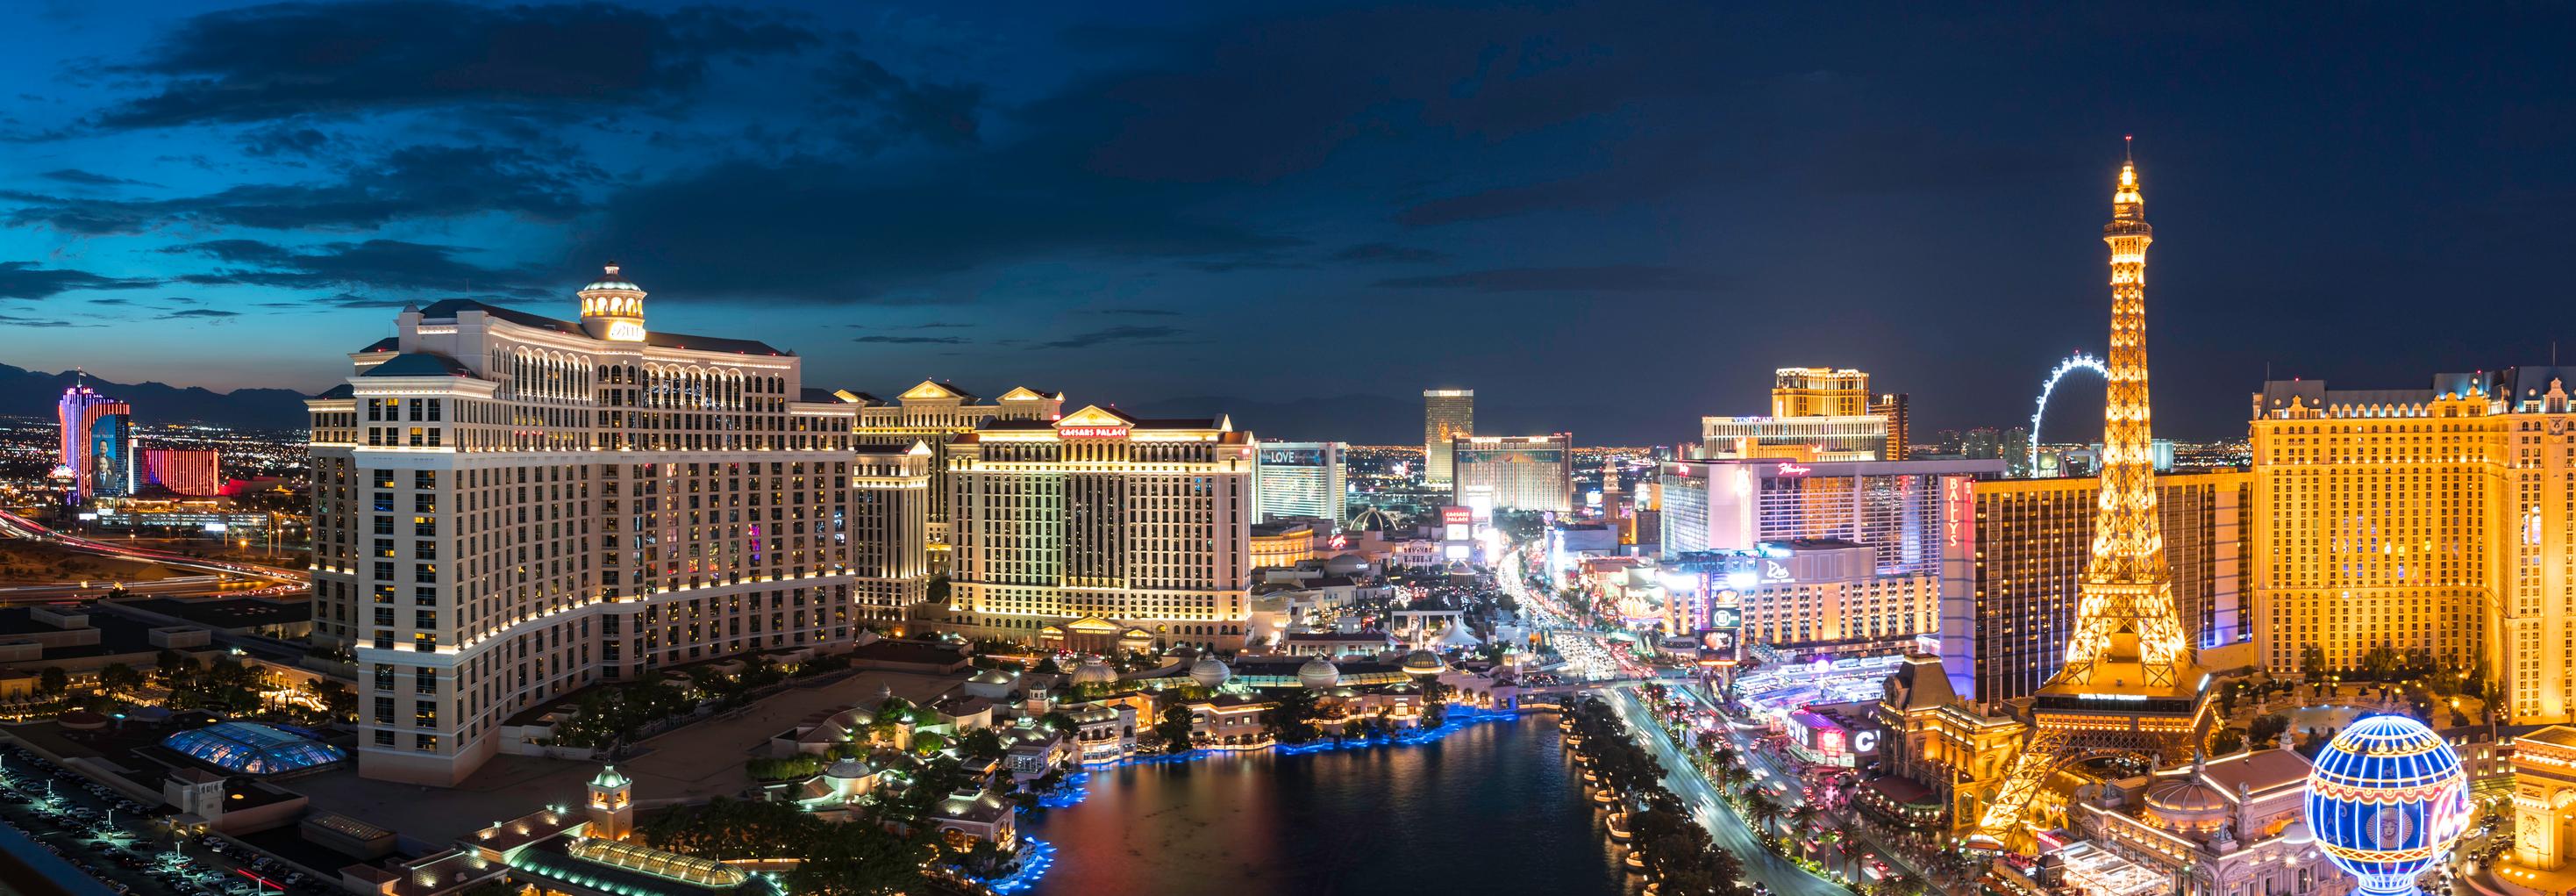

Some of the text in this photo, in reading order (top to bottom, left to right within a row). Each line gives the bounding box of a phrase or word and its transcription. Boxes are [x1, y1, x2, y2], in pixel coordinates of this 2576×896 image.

[1271, 451, 1295, 463] LOVE
[1788, 717, 1809, 746] CVS
[1855, 730, 1880, 752] C
